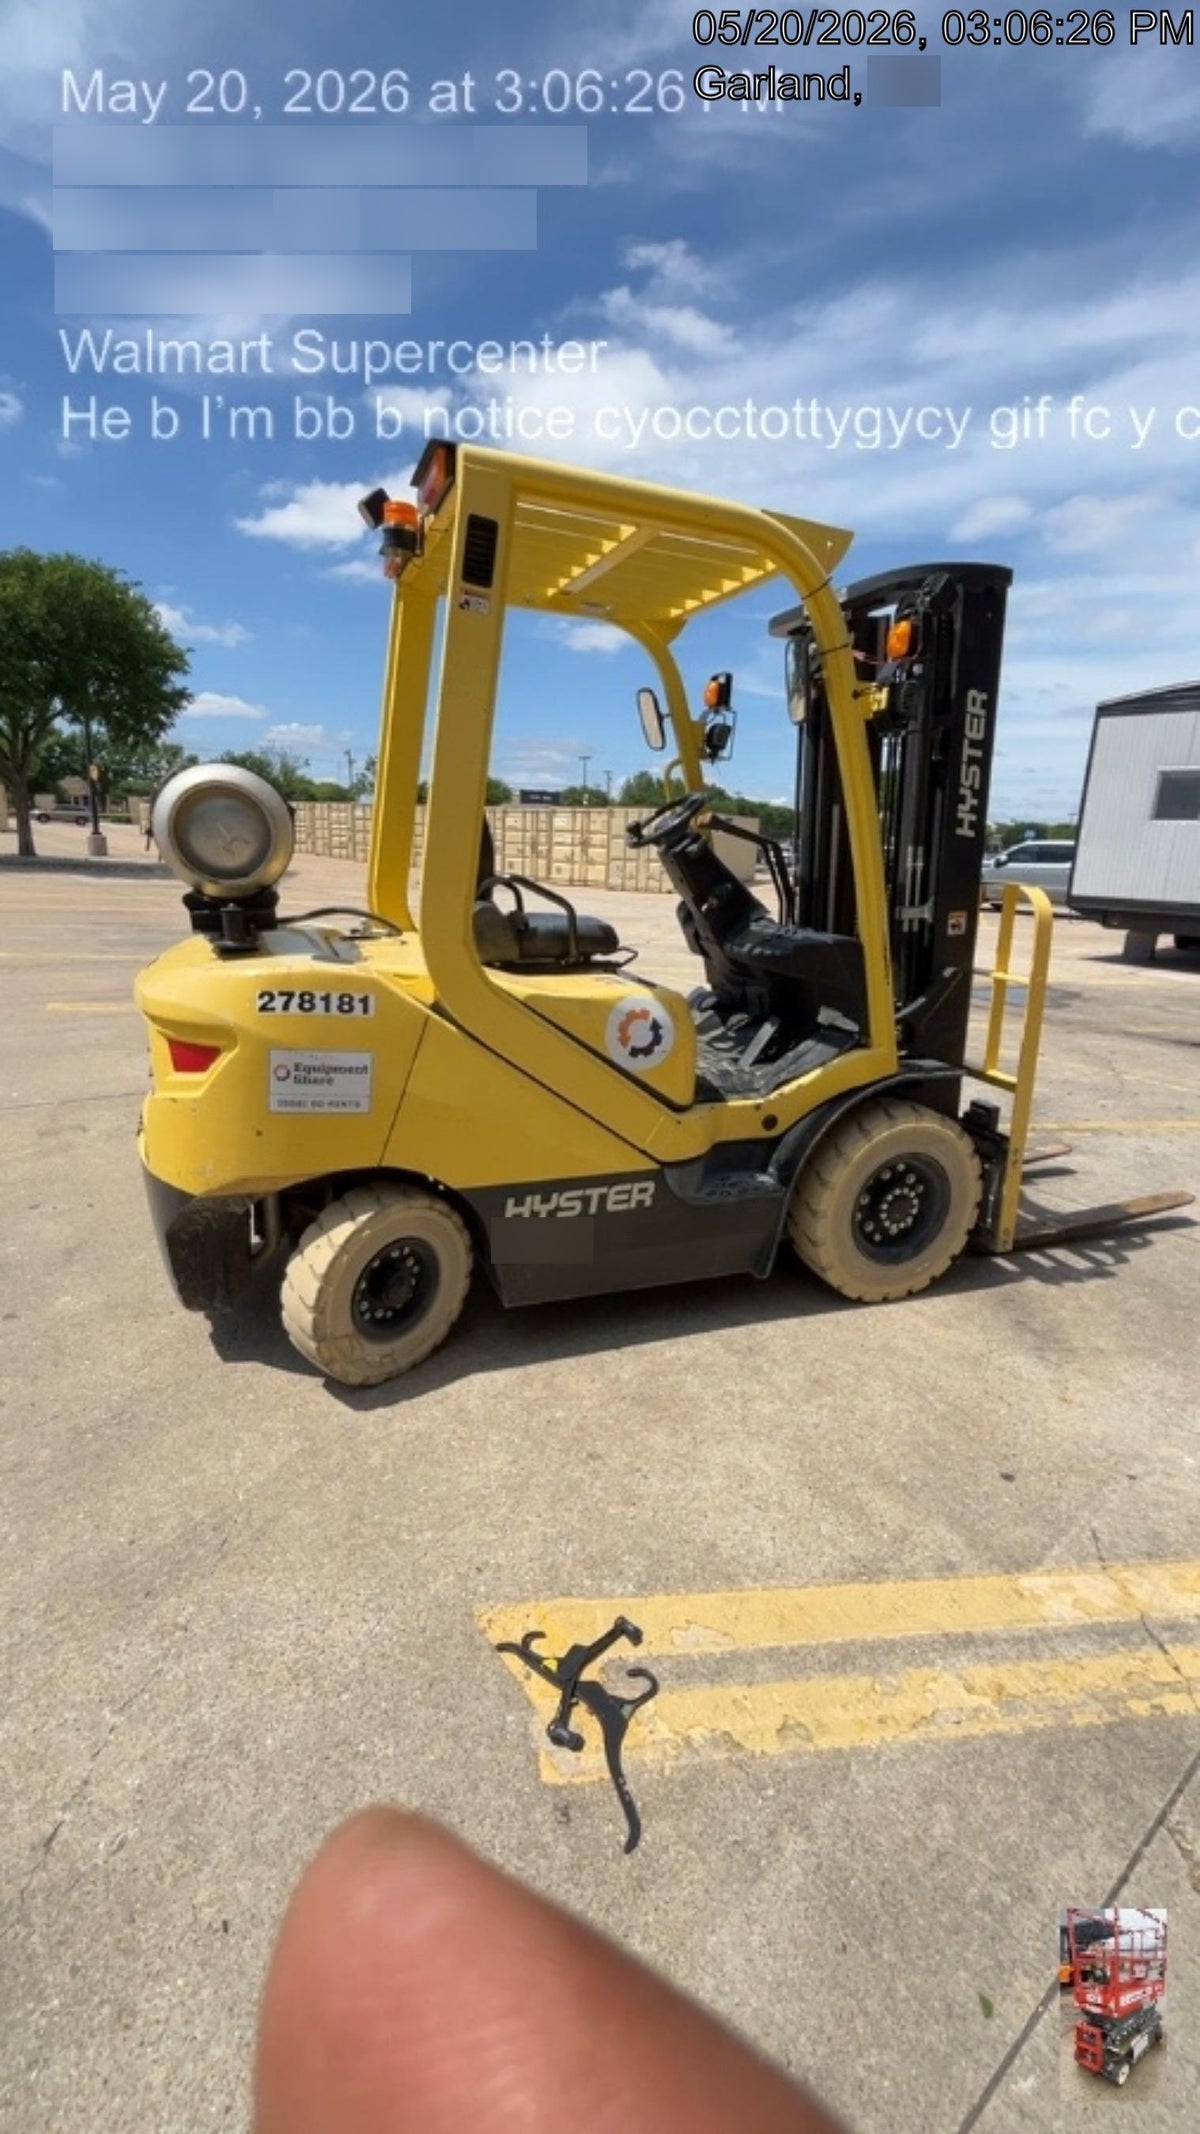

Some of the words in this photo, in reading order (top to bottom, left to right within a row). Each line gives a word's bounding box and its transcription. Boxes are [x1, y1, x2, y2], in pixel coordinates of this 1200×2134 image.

[955, 688, 988, 838] HYSTER
[257, 990, 371, 1015] 278181
[504, 1181, 655, 1218] HYSTER
